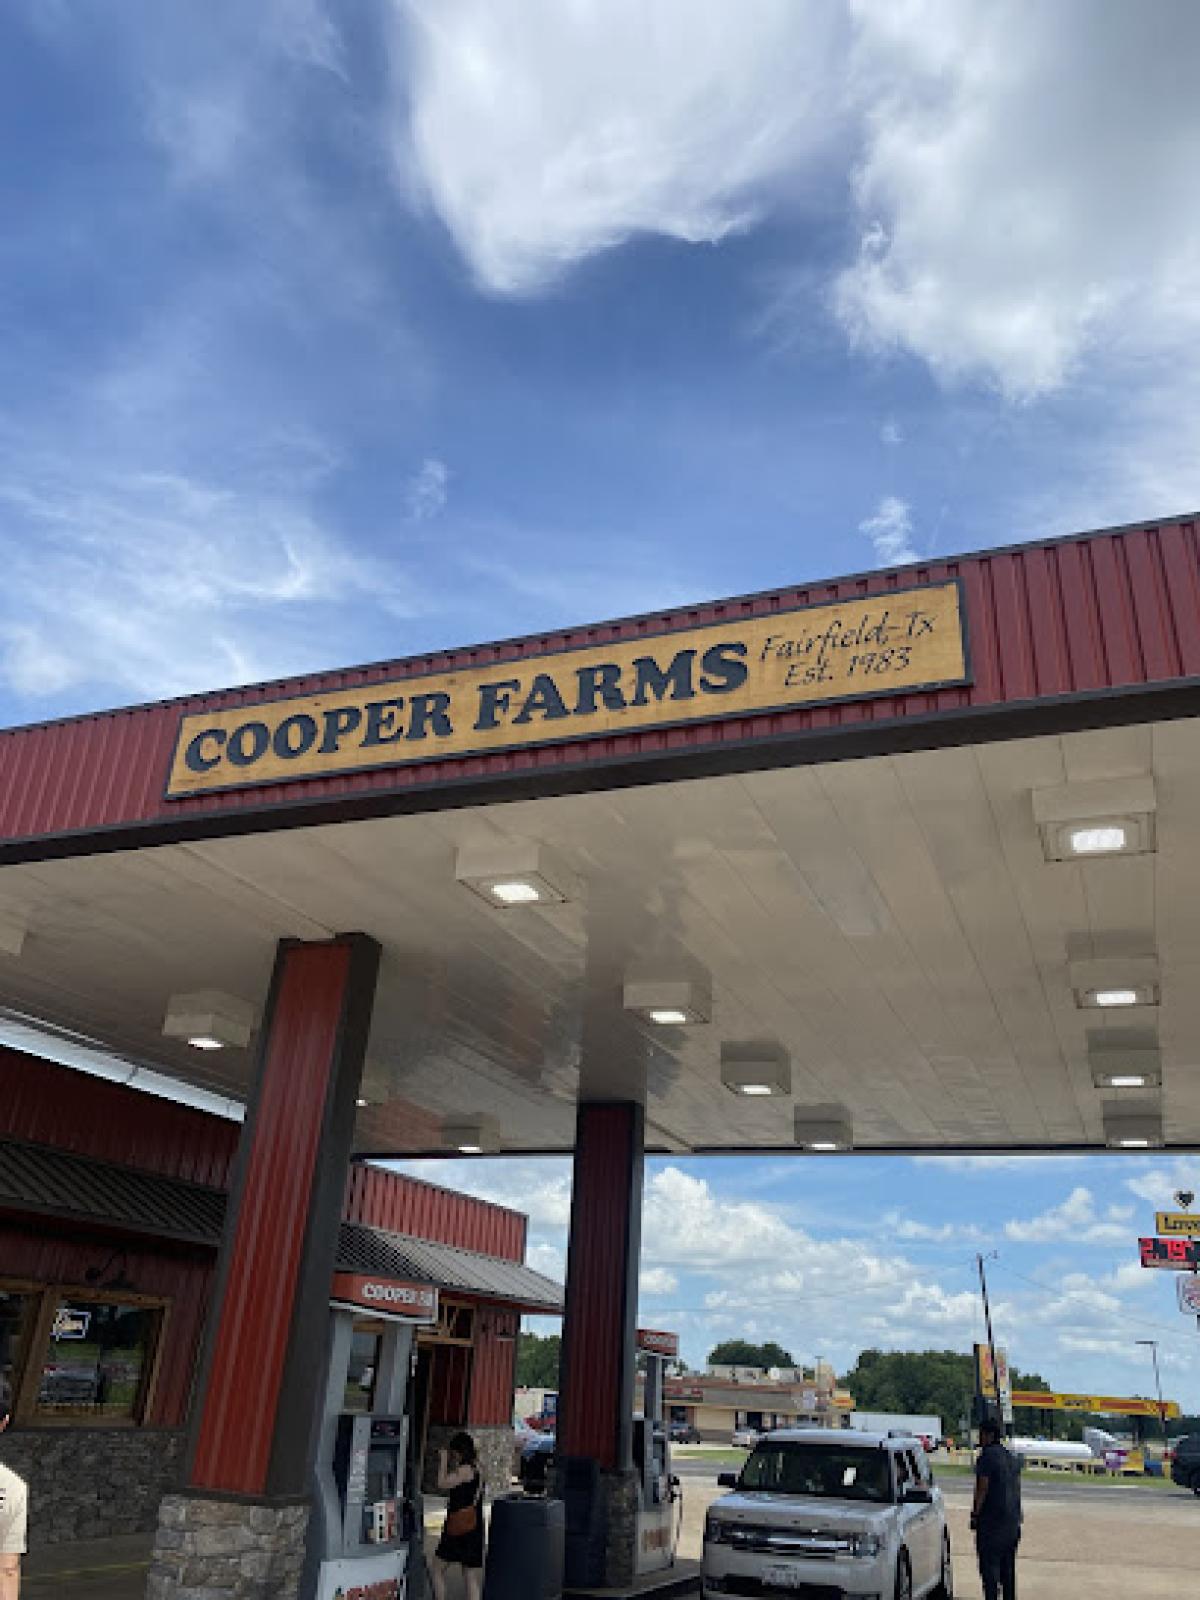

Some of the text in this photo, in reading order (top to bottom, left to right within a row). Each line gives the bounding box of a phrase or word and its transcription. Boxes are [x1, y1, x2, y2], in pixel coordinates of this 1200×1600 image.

[847, 646, 912, 677] 1983
[185, 642, 748, 772] COOPER FARMS
